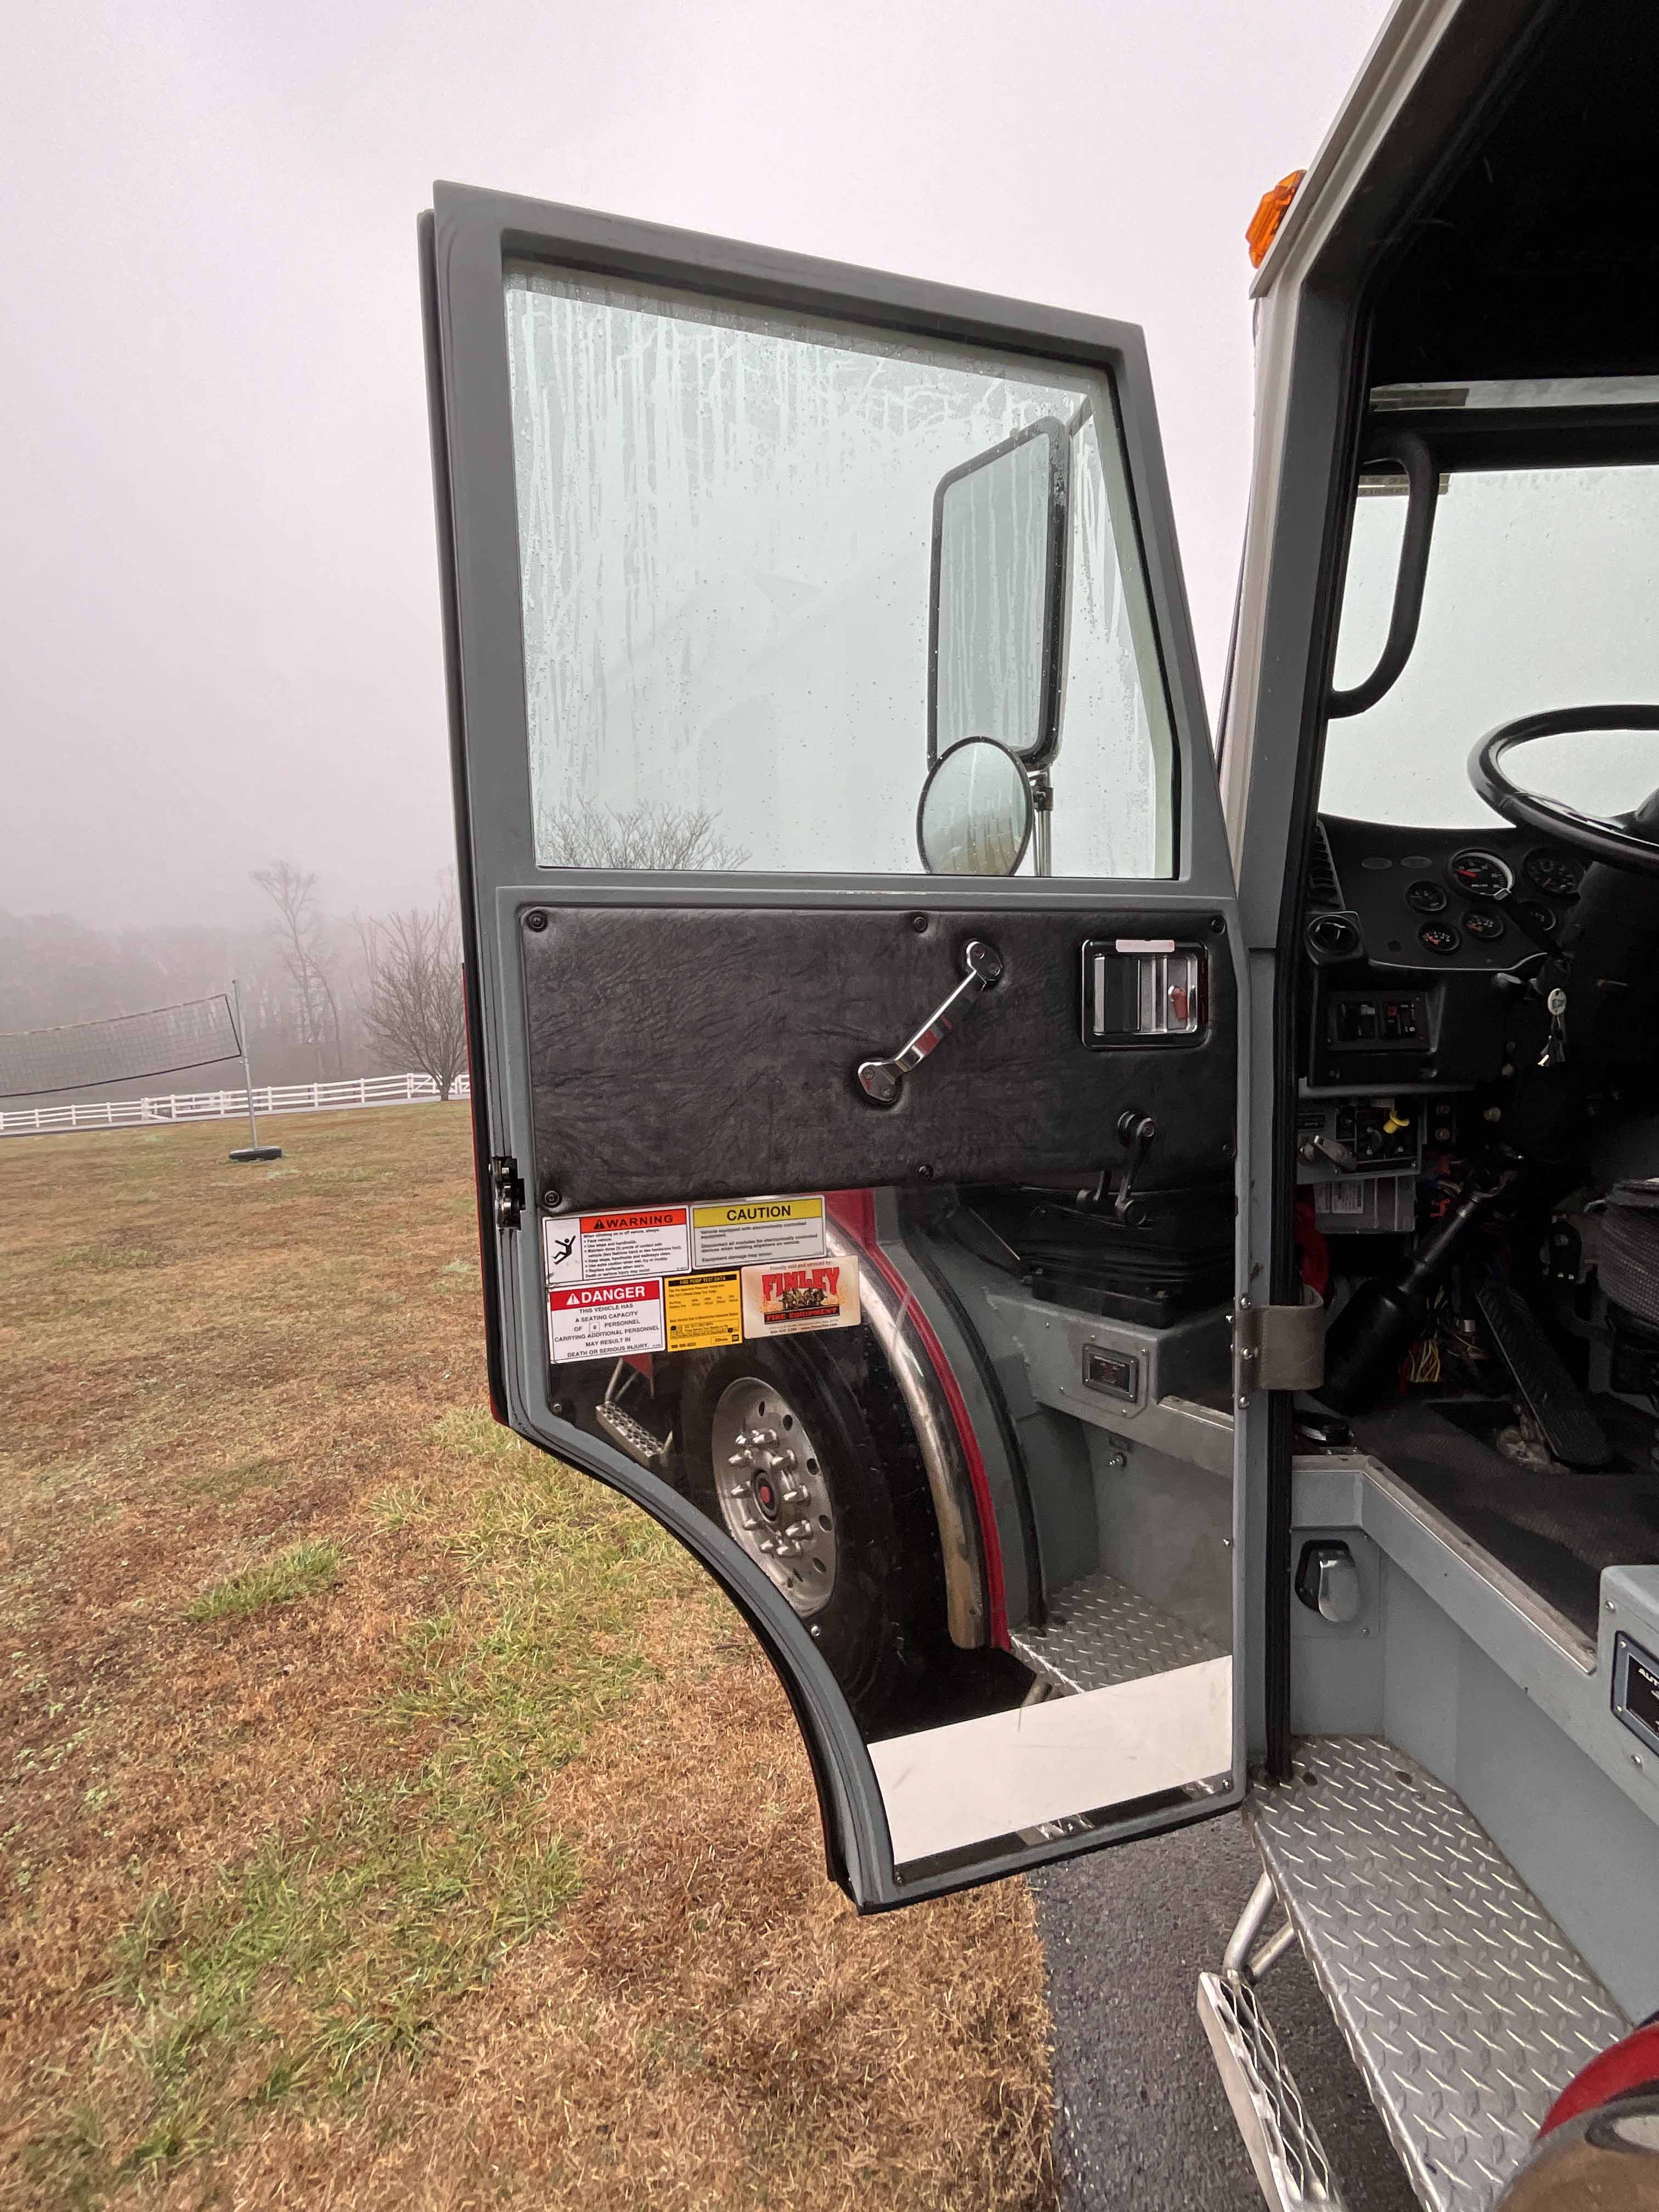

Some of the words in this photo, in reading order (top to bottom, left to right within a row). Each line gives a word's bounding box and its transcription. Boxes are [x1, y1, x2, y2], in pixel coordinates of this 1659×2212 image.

[727, 1205, 791, 1221] CAUTION
[607, 1215, 673, 1228] WARNING
[762, 1266, 839, 1301] FINLEY
[581, 1285, 646, 1304] DANGER
[581, 1314, 607, 1323] SEATING
[608, 1311, 638, 1319] CAPACITY
[605, 1319, 641, 1328] PERSONNEL
[554, 1334, 586, 1342] CARRYING
[588, 1329, 623, 1339] ADDITIONAL
[624, 1325, 660, 1334] PERSONNEL
[600, 1337, 623, 1346] RESULT
[599, 1346, 626, 1354] SERIOUS
